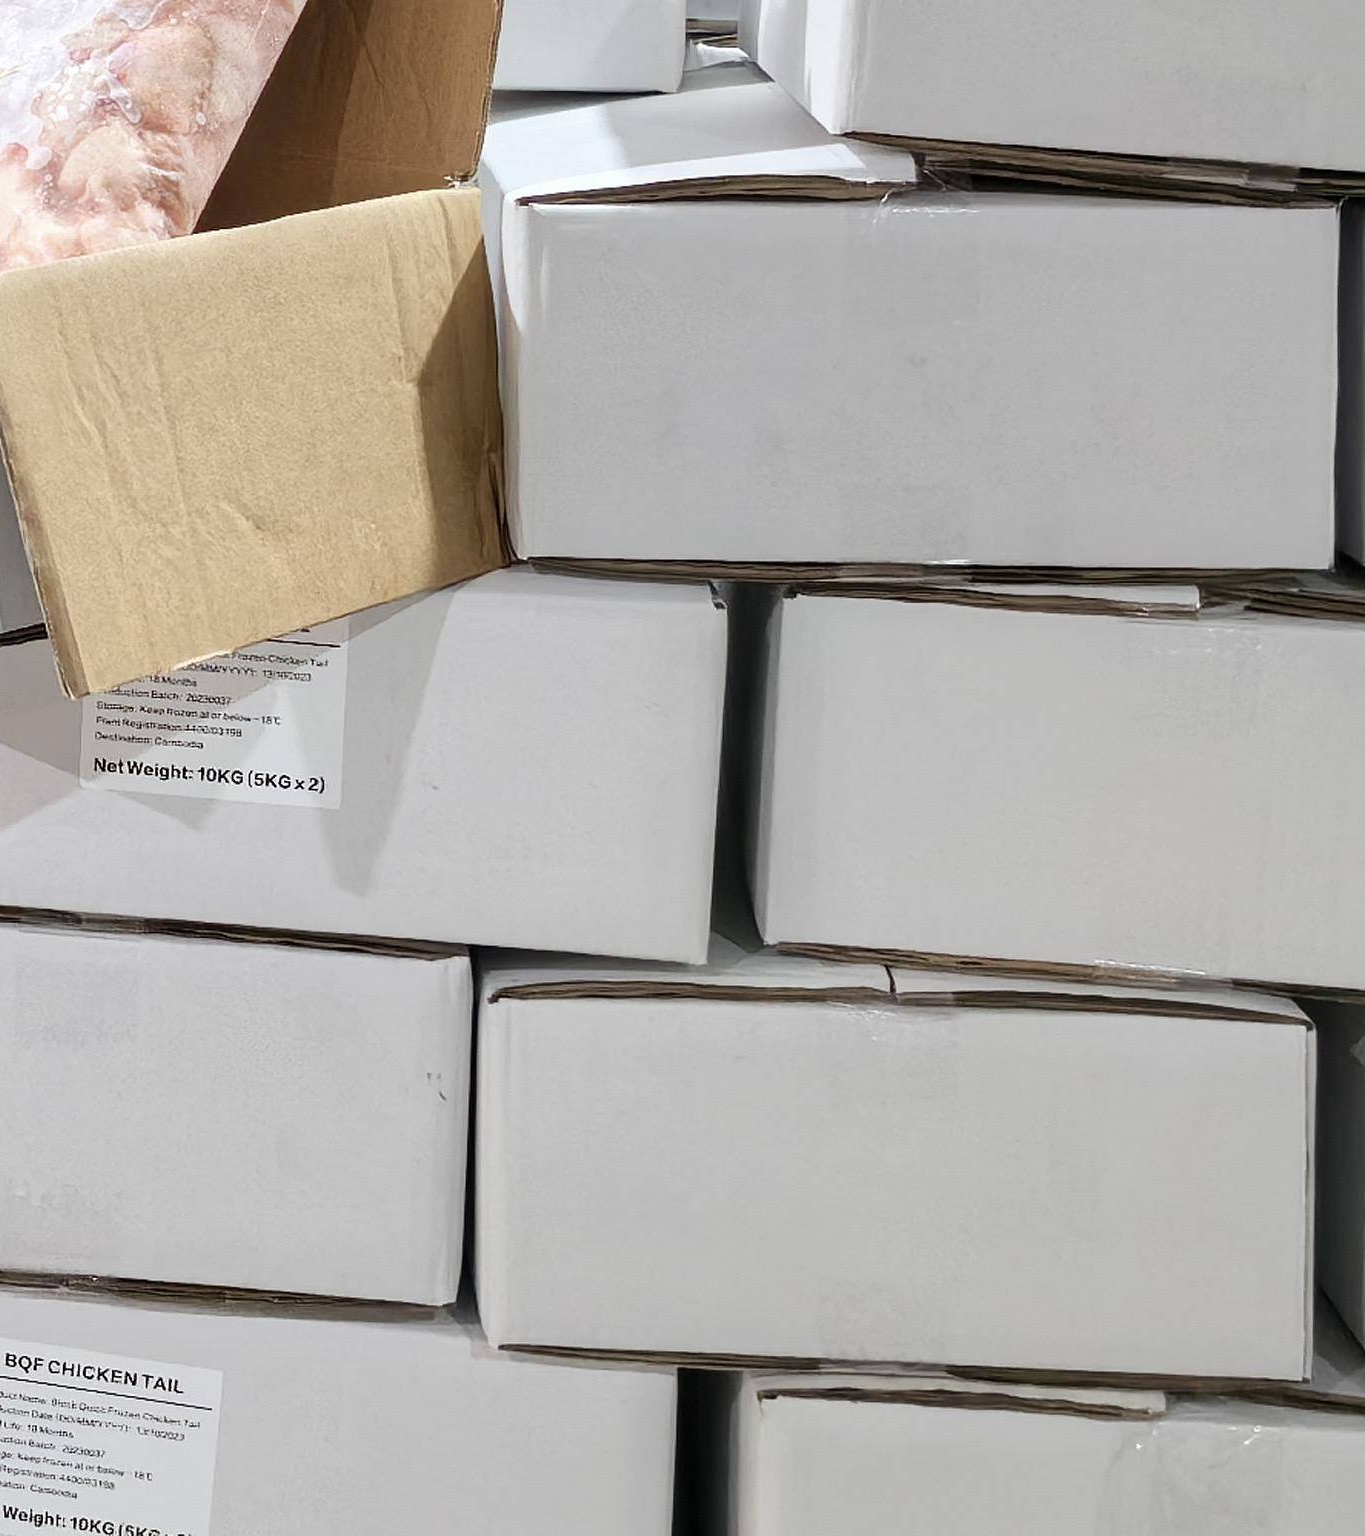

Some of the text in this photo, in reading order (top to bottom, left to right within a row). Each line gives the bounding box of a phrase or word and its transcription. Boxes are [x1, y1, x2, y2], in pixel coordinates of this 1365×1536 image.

[93, 757, 325, 794] Net Weight: 10KG (5KG x 2)
[5, 1352, 184, 1394] BQF CHICKEN TAIL
[2, 1504, 66, 1530] Weight:
[70, 1514, 114, 1535] 10KG
